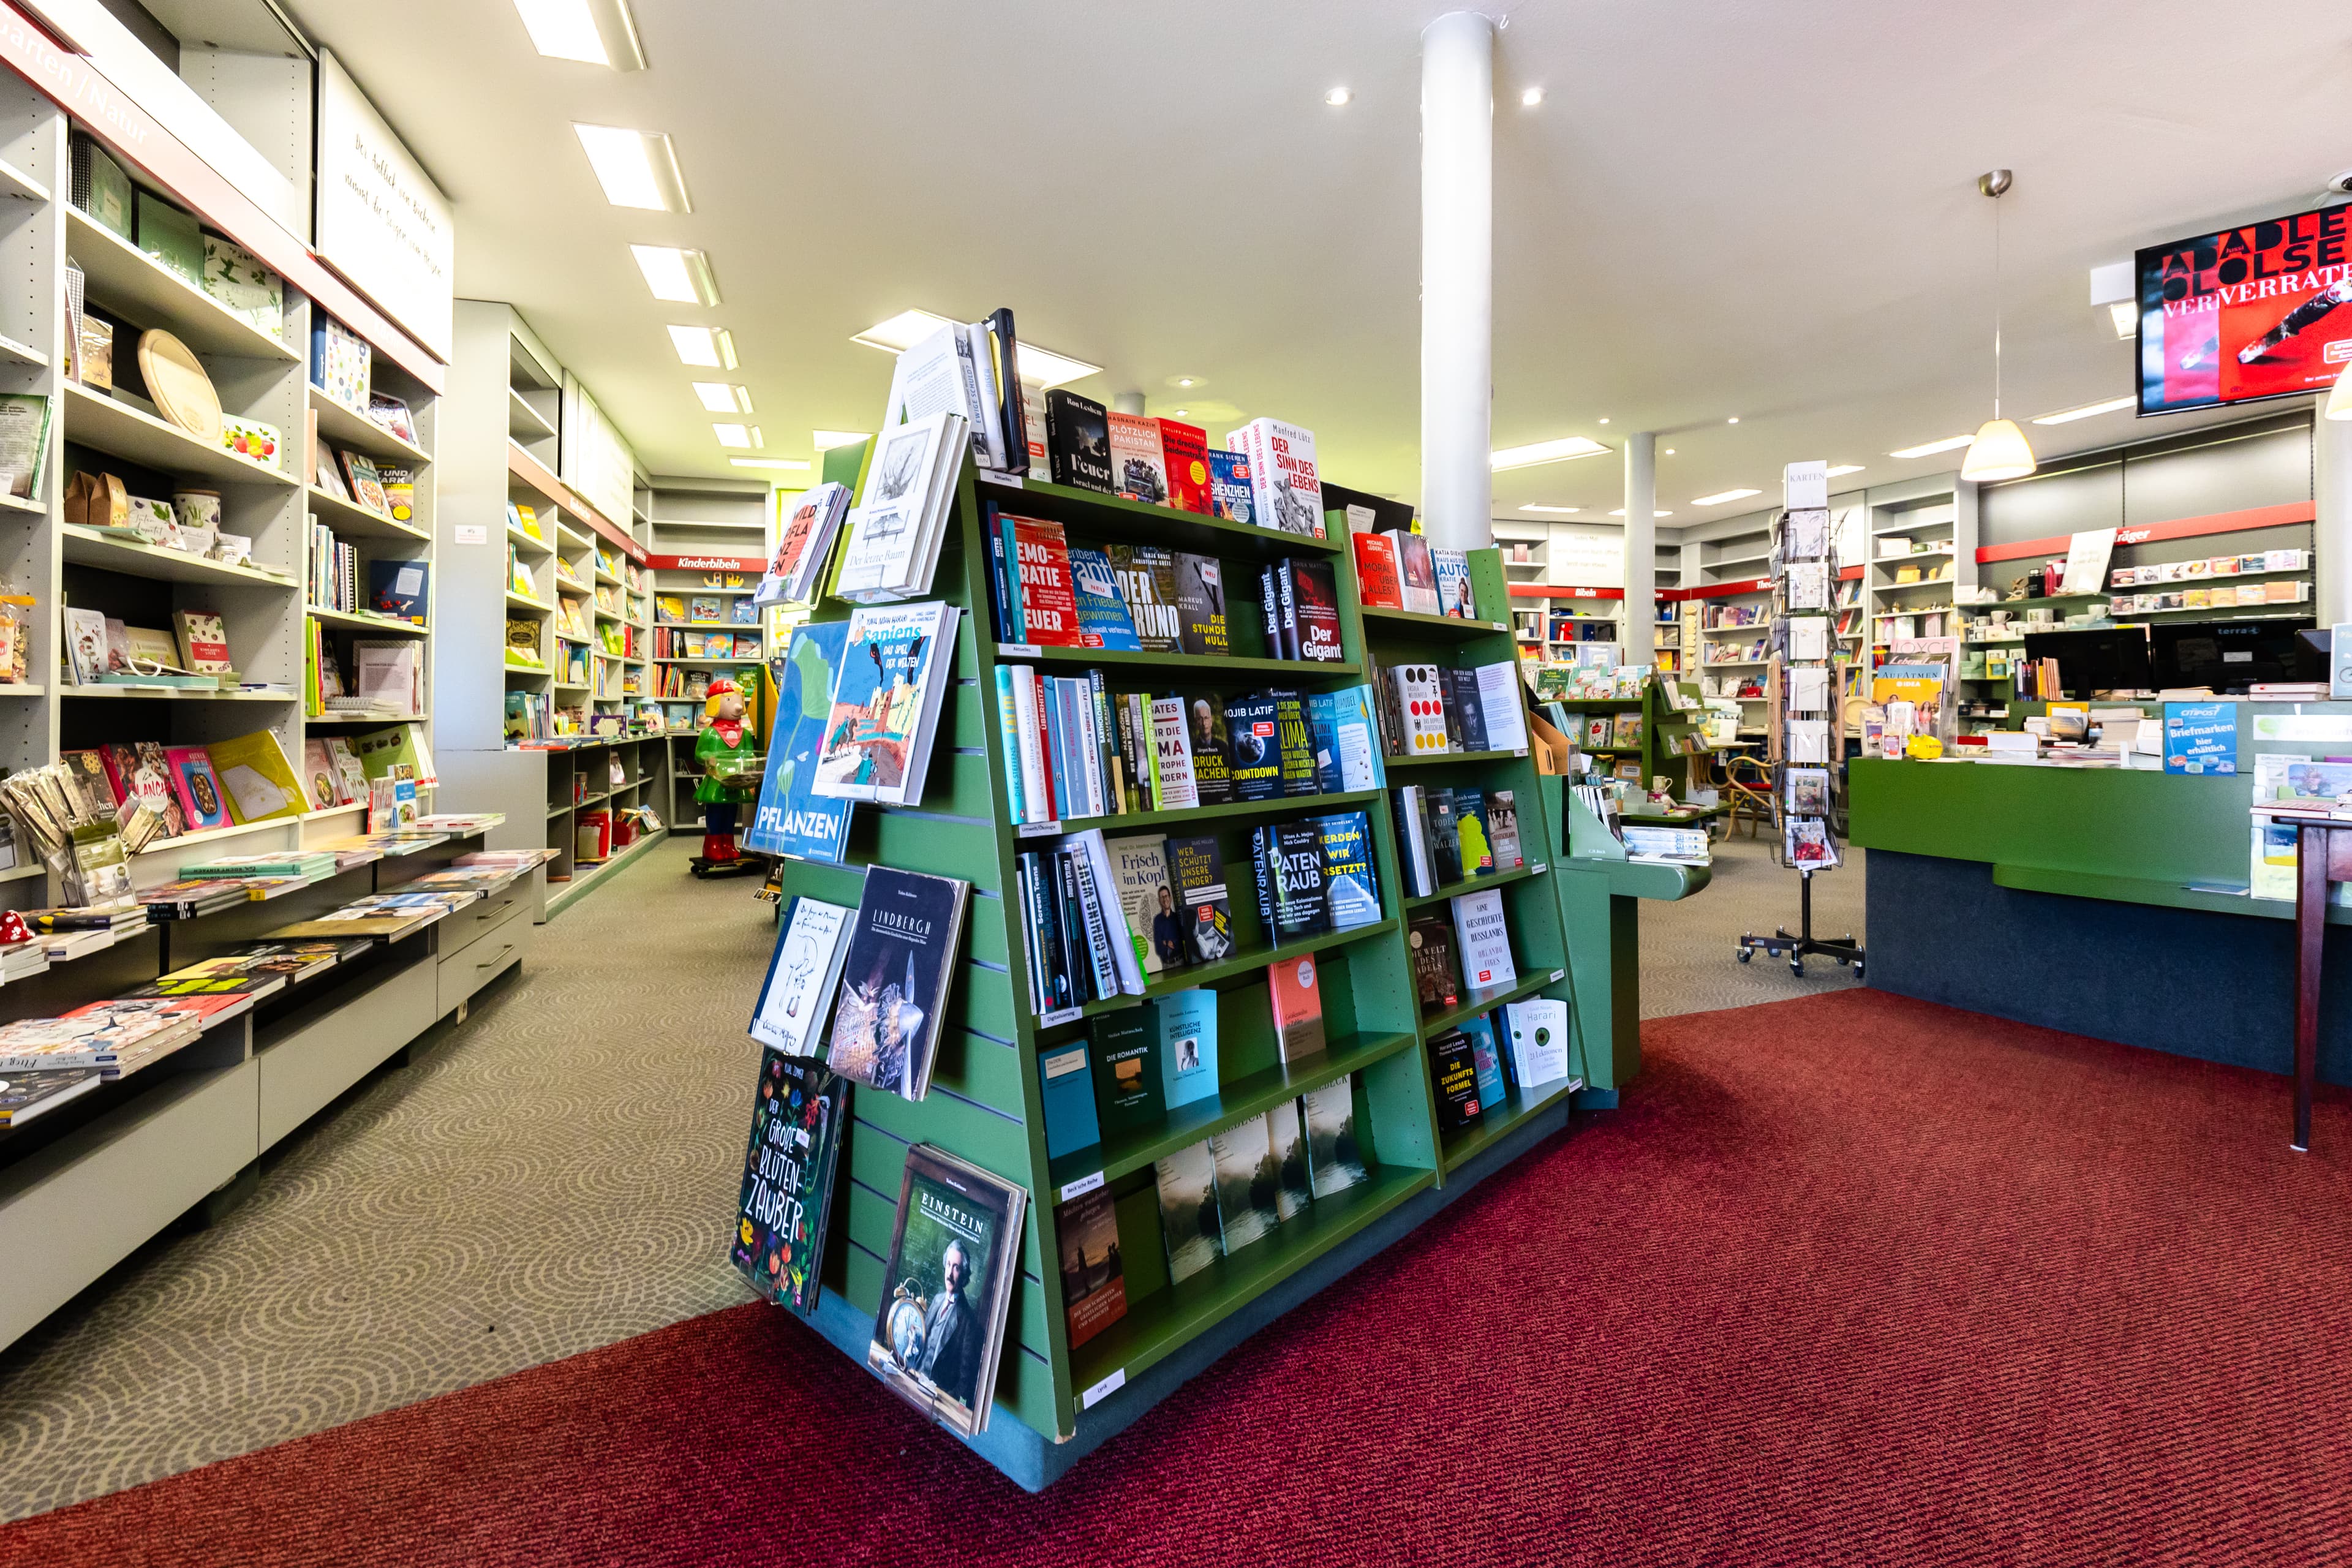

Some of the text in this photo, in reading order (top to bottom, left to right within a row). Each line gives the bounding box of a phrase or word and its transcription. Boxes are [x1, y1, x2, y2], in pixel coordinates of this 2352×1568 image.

[89, 83, 147, 145] Natur
[2220, 206, 2347, 258] ADLE
[2218, 235, 2346, 285] OLSE
[2218, 263, 2352, 305] VERRATE
[967, 364, 976, 397] SCHULD?
[971, 398, 981, 423] EWIGE
[1067, 397, 1102, 417] Ron Leshem
[1107, 415, 1136, 424] HASNAIN
[1110, 424, 1156, 440] PLÖTZLICH
[1163, 426, 1182, 435] PHILIPP
[1253, 424, 1262, 447] LEBENS
[1273, 424, 1311, 443] Manfred Lütz
[1114, 435, 1155, 448] PAKISTAN
[1164, 435, 1205, 453] Die dreckige
[1271, 435, 1289, 454] DER
[1164, 445, 1206, 461] Seidenstraße
[1226, 454, 1245, 462] SIEREN
[1071, 453, 1110, 481] Feuer
[1276, 454, 1314, 477] SINN DES
[1288, 472, 1320, 494] LEBENS
[1790, 472, 1825, 483] KARTEN
[1072, 477, 1112, 496] Israel und der
[1211, 483, 1251, 499] SHENZHEN
[794, 504, 818, 521] WILD
[2117, 528, 2150, 543] räger
[1016, 541, 1054, 564] EMO-
[678, 558, 741, 570] Kinderbibeln
[1364, 562, 1392, 574] MORAL
[1439, 563, 1470, 578] AUTO
[1019, 563, 1061, 587] RATIE
[1204, 569, 1216, 579] NEU
[1379, 574, 1398, 586] ÜBER
[1090, 584, 1106, 593] NEU
[1117, 570, 1152, 604] DER
[1368, 585, 1395, 595] ALLES?
[1575, 588, 1597, 597] Bibeln
[1088, 594, 1125, 609] Frieden
[1178, 595, 1203, 605] MARKUS
[1262, 573, 1278, 635] Der Gigant
[1278, 565, 1294, 630] Der Gigant
[1023, 608, 1063, 631] EUER
[1077, 609, 1125, 623] gewinnen
[1131, 603, 1181, 638] RUND
[1210, 613, 1225, 625] DIE
[861, 625, 922, 647] Sapiens
[1089, 625, 1107, 635] Gewalt
[1192, 624, 1227, 636] STUNDE
[1310, 625, 1332, 642] Der
[1204, 635, 1228, 647] NULL
[1895, 641, 1951, 653] JOYCE
[883, 644, 908, 656] DAS SPIEL
[1302, 640, 1343, 663] Gigant
[886, 656, 921, 669] DER WELTEN
[1037, 683, 1047, 730] ÜBERHITZT
[1248, 705, 1273, 716] LATIF
[2180, 706, 2220, 717] CITIPOST
[1166, 726, 1182, 737] DIE
[2170, 723, 2234, 739] Briefmarken
[2195, 737, 2212, 746] hier
[2187, 744, 2226, 755] erhältlich
[1009, 746, 1019, 778] STEFFENS
[1194, 754, 1223, 768] DRUCK
[758, 805, 840, 842] PFLANZEN
[1434, 817, 1456, 828] TODES
[1177, 847, 1194, 858] WER
[1327, 848, 1350, 861] WIR
[1121, 851, 1159, 870] Frisch
[1178, 854, 1212, 868] SCHÜTZT
[1268, 851, 1321, 875] DATEN
[1123, 864, 1167, 887] im Kopf
[1181, 865, 1209, 878] UNSERE
[1252, 833, 1271, 917] DATENRAUB
[1322, 862, 1367, 876] RSETZT?
[1182, 875, 1213, 888] KINDER?
[1276, 870, 1321, 893] RAUB
[1476, 903, 1489, 913] EINE
[873, 908, 932, 935] LINDBERGH
[1077, 863, 1112, 980] THE COMING WAVE
[1466, 913, 1503, 929] GESCHICHTE
[1470, 927, 1504, 943] RUSSLANDS
[1424, 944, 1446, 955] WELT
[1477, 945, 1504, 959] ORLANDO
[1420, 956, 1436, 965] DES
[1484, 957, 1501, 968] FIGES
[1416, 962, 1442, 975] ADELS
[1047, 1010, 1076, 1022] Digitalisierung
[1527, 1011, 1556, 1023] Harari
[1169, 1020, 1201, 1033] KÜNSTLICHE
[1169, 1027, 1201, 1040] INTELLIGENZ
[1439, 1039, 1465, 1052] Harald Lesch
[1106, 1046, 1149, 1062] DIE ROMANTIK
[1536, 1047, 1563, 1060] Lektionen
[1450, 1060, 1461, 1072] DIE
[1441, 1068, 1474, 1086] ZUKUNFTS
[1446, 1079, 1472, 1095] FORMEL
[769, 1098, 780, 1115] DER
[759, 1150, 803, 1193] BLÜTEN-
[1087, 1177, 1098, 1186] Reihe
[744, 1172, 804, 1245] ZAUBER
[921, 1192, 984, 1234] EINSTEIN
[1074, 1287, 1115, 1319] DIE 100 SCHÖNSTEN
[1080, 1290, 1123, 1322] GEISTLICHEN LIEDER
[1078, 1306, 1110, 1330] UND GEDICHTE
[1096, 1382, 1108, 1394] Lyrik
